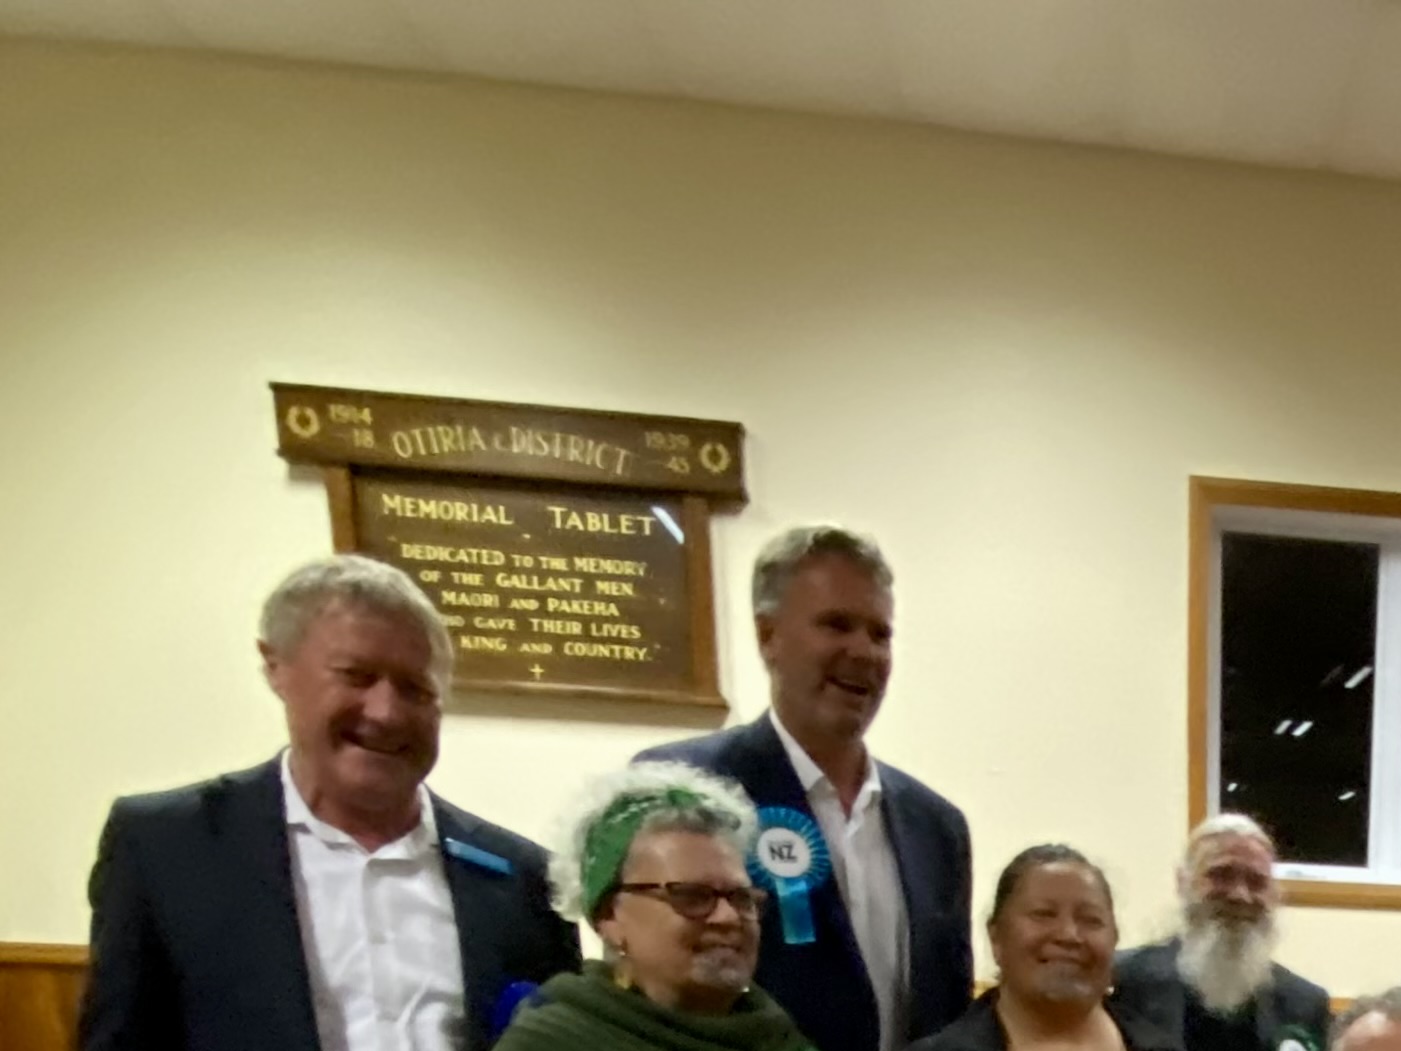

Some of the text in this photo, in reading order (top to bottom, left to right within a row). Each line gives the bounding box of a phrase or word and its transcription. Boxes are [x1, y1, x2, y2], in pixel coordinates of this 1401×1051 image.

[392, 424, 487, 458] OTIRIA
[509, 426, 630, 475] DISTRICT
[382, 493, 656, 535] MEMORIAL TABLET
[400, 543, 648, 577] DEDICATED TO THE MEMORY
[419, 569, 634, 596] OF THE GALLANT MEN
[441, 590, 620, 617] MAORI AND PAKEHA
[473, 616, 517, 631] GAVE
[529, 618, 582, 635] THEIR
[591, 622, 641, 639] LIVES
[460, 635, 507, 651] KING
[519, 642, 553, 654] AND
[769, 843, 799, 862] NZ
